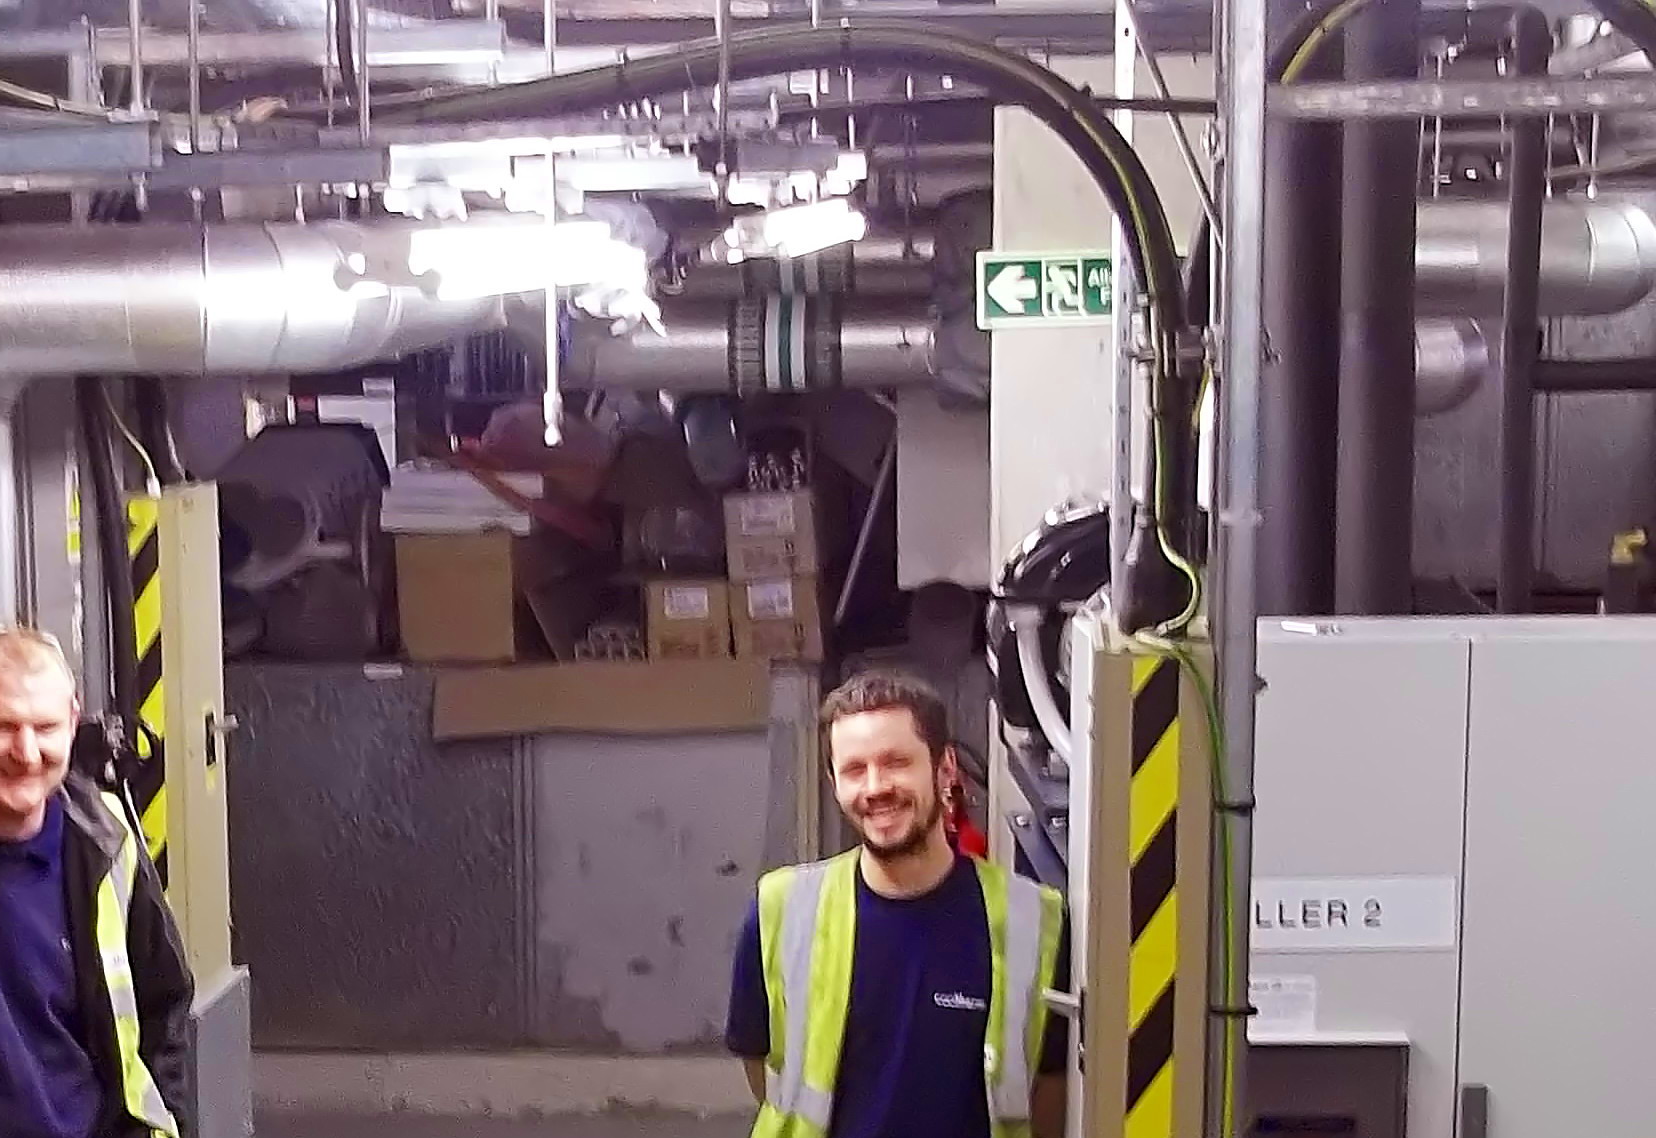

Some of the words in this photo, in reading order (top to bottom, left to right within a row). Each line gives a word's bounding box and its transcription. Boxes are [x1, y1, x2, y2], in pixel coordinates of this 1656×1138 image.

[1087, 266, 1112, 288] All
[1100, 286, 1112, 306] F
[1255, 899, 1348, 928] LLER
[1362, 897, 1382, 928] 2
